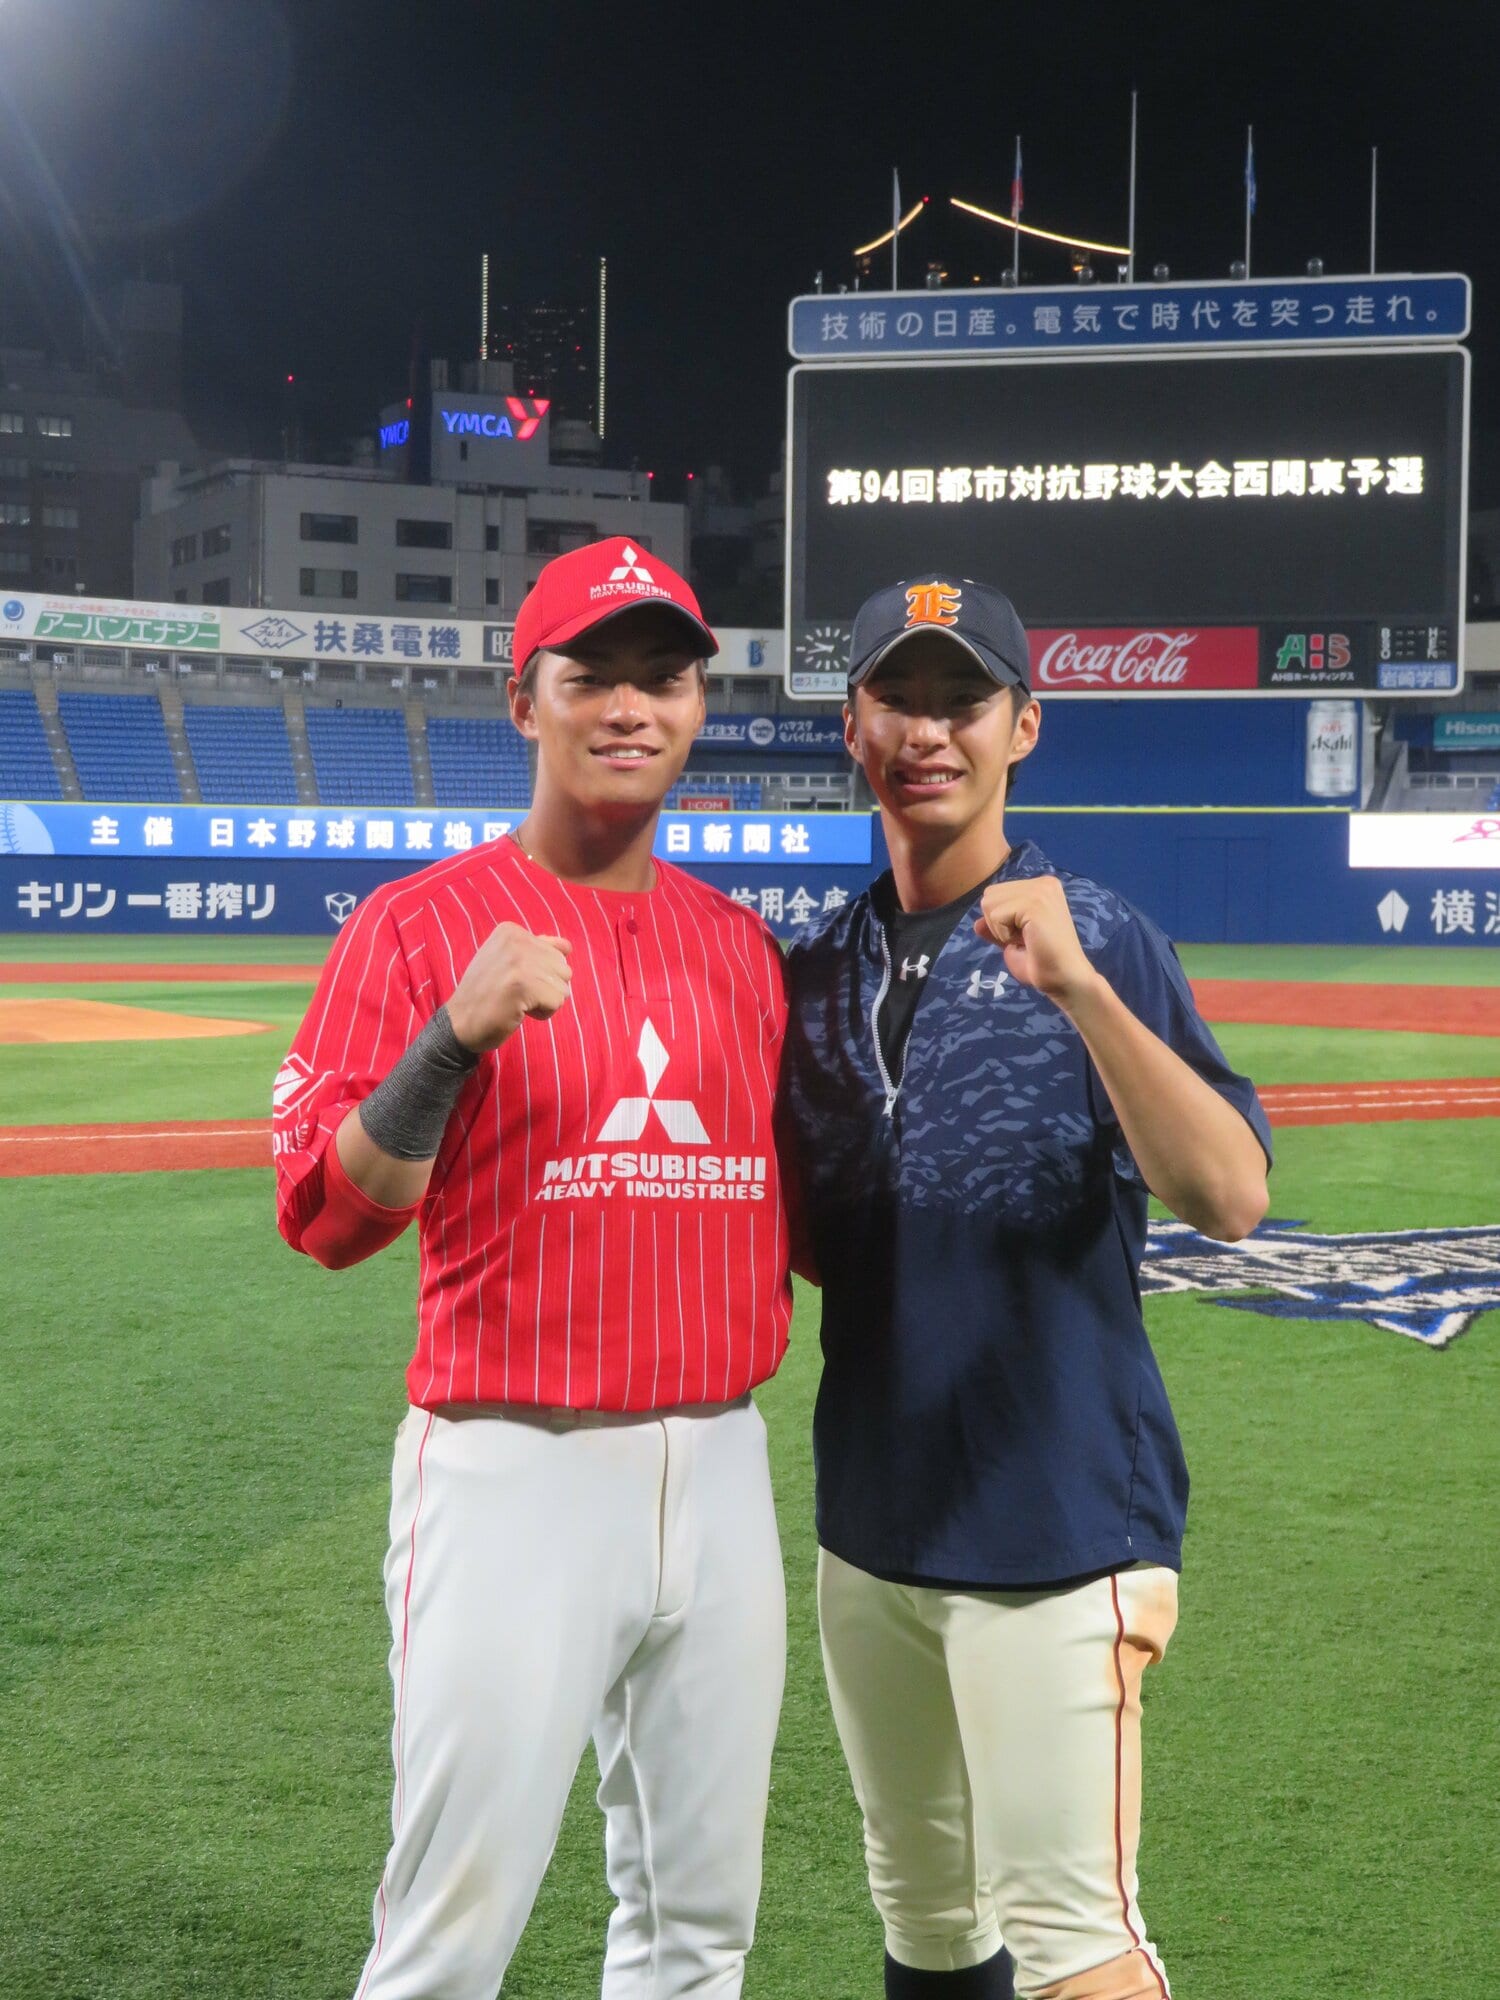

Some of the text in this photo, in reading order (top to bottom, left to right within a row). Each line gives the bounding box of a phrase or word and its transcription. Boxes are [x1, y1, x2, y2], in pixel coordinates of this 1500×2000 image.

[820, 294, 1440, 342] 技術の日産。電気で時代を突っ走れ。
[381, 420, 410, 449] YMCA
[441, 410, 513, 440] YMCA
[826, 456, 1424, 506] 第94回都市対抗野球大会西関東予選
[590, 582, 672, 600] MITSUBISHI
[41, 612, 219, 645] アーバンエナジー
[314, 620, 461, 660] 扶桑電機
[1039, 632, 1198, 684] Coca-Cola
[1312, 734, 1352, 751] Asahi
[18, 881, 276, 919] キリン一番搾り
[543, 1152, 766, 1182] MITSUBISHI
[535, 1180, 765, 1201] HEAVY INDUSTRIES
